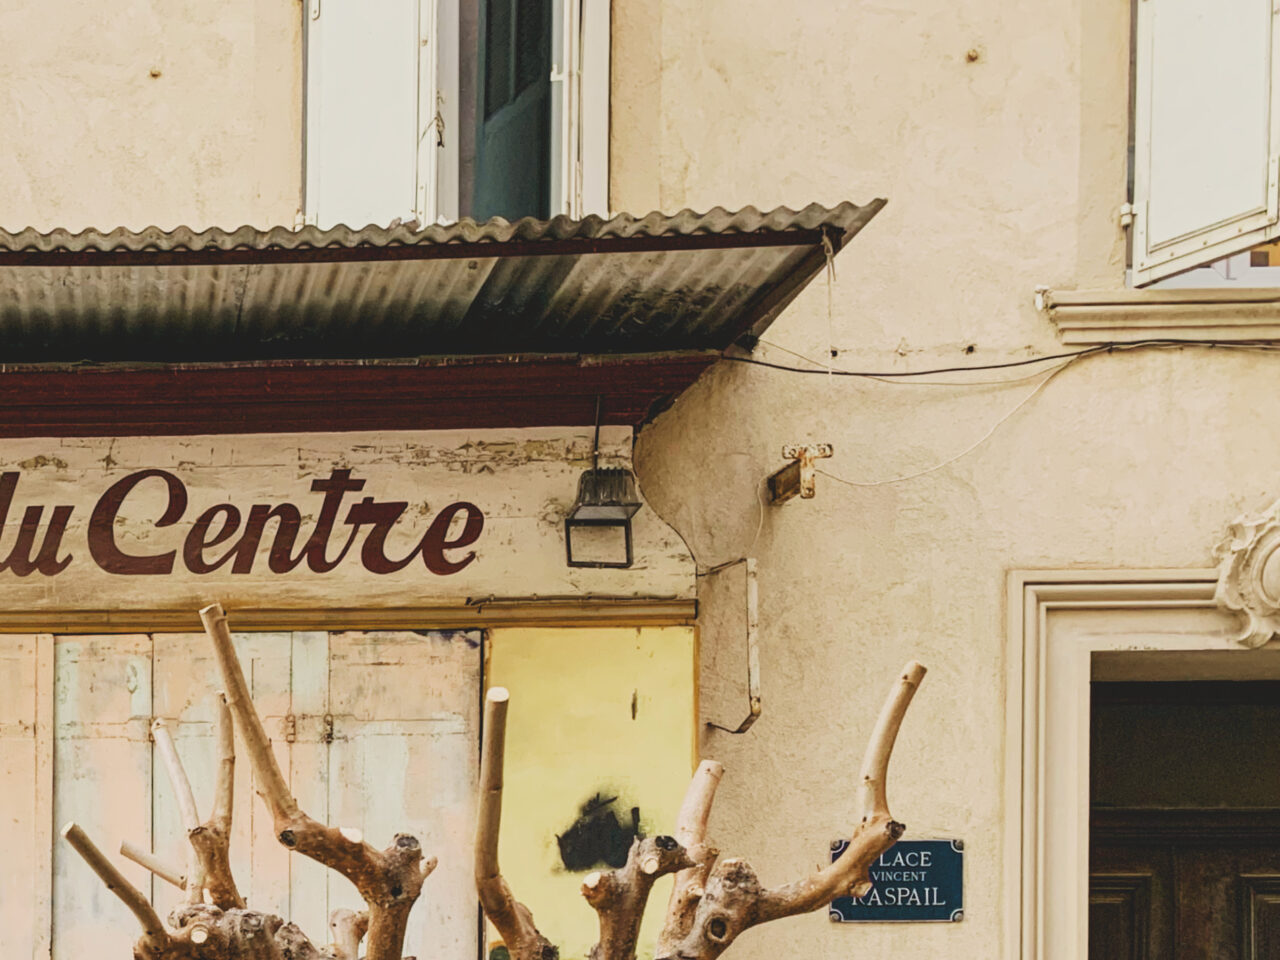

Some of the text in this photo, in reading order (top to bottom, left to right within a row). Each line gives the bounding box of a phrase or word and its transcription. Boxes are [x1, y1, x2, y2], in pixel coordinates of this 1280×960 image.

[87, 468, 485, 577] Centre
[879, 851, 932, 867] LACE
[871, 871, 927, 882] VINCENT
